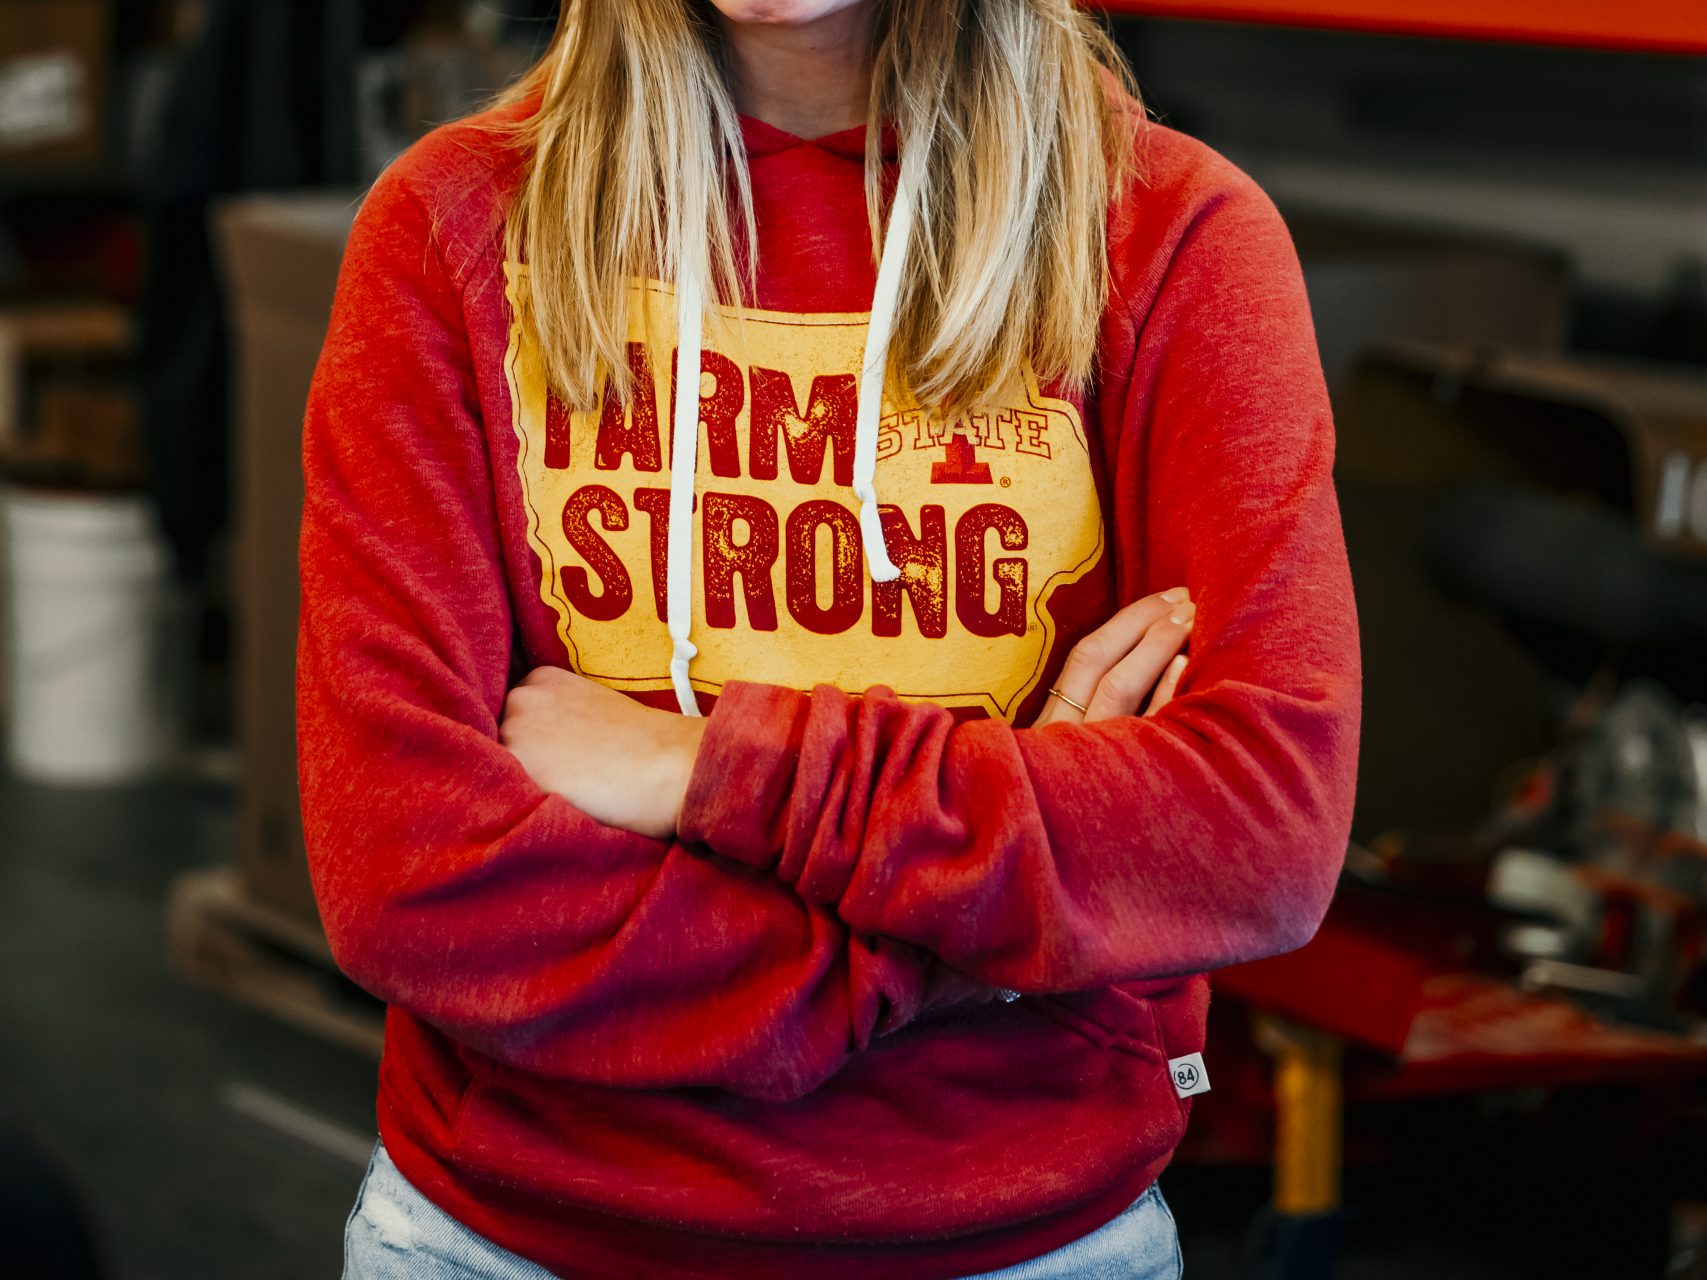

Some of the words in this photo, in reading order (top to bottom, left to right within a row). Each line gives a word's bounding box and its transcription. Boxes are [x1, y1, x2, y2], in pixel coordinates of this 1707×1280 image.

[875, 408, 1052, 461] STATE
[560, 484, 1029, 640] STRONG
[1177, 1067, 1195, 1085] 84
